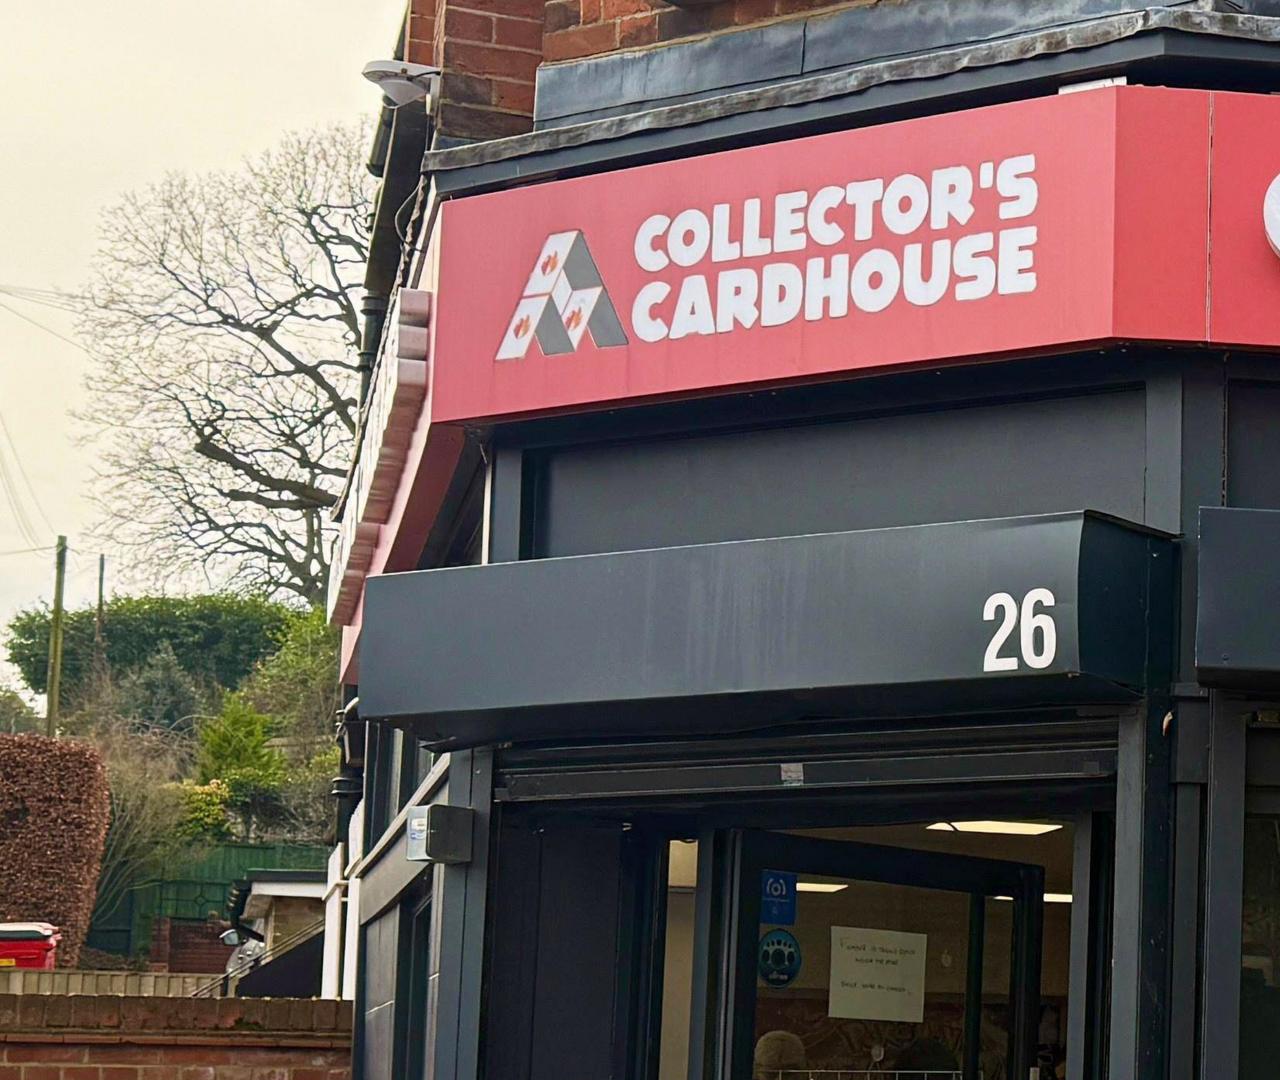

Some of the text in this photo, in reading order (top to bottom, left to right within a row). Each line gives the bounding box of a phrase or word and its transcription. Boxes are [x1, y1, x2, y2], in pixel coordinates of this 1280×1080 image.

[634, 154, 1038, 271] COLLECTOR'S
[631, 226, 1038, 343] CARDHOUSE
[982, 588, 1056, 673] 26
